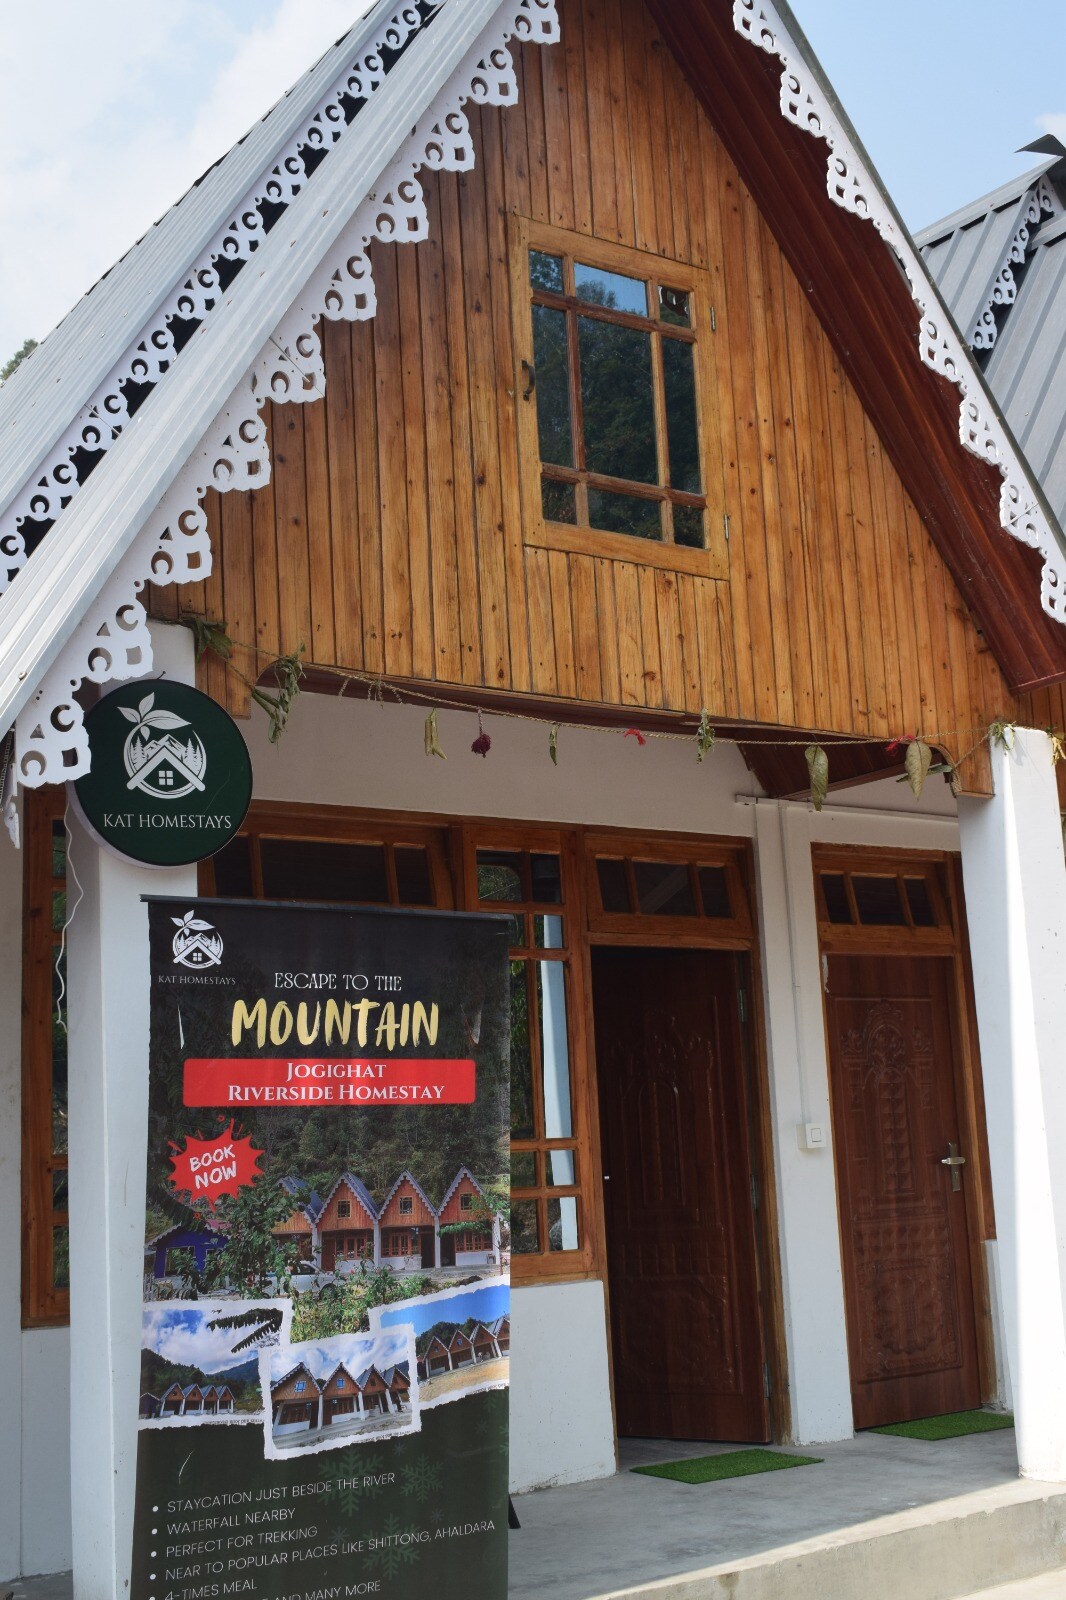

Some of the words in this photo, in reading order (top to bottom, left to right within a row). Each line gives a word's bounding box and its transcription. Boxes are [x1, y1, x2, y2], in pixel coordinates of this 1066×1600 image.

[104, 814, 135, 828] KAT
[139, 814, 232, 829] HOMESTAYS
[158, 975, 177, 984] KAT
[180, 976, 236, 986] HOMESTAYS
[274, 972, 337, 990] ESCAPE
[343, 974, 369, 991] TO
[375, 975, 402, 992] THE
[231, 997, 439, 1051] MOUNTAIN
[286, 1062, 387, 1081] JOGIGHAT
[228, 1085, 334, 1102] RIVERSIDE
[338, 1084, 445, 1101] HOMESTAY
[189, 1144, 236, 1172] BOOK
[194, 1160, 238, 1189] NOW
[167, 1490, 252, 1514] STAYCATION
[256, 1486, 288, 1502] JUST
[292, 1480, 332, 1498] BESIDE
[336, 1477, 359, 1491] THE
[362, 1472, 395, 1488] RIVER
[167, 1512, 241, 1535] WATERFALL
[245, 1508, 296, 1524] NEARBY
[165, 1562, 201, 1581] NEAR
[205, 1560, 223, 1575] TO
[228, 1552, 288, 1572] POPULAR
[292, 1544, 338, 1562] PLACES
[342, 1541, 364, 1554] LIKE
[434, 1520, 495, 1540] AHALDARA
[166, 1538, 224, 1558] PERFECT
[227, 1534, 254, 1549] FOR
[258, 1526, 318, 1545] TREKKING
[223, 1578, 258, 1593] MEAL
[308, 1586, 343, 1600] MANY
[345, 1579, 381, 1595] MORE
